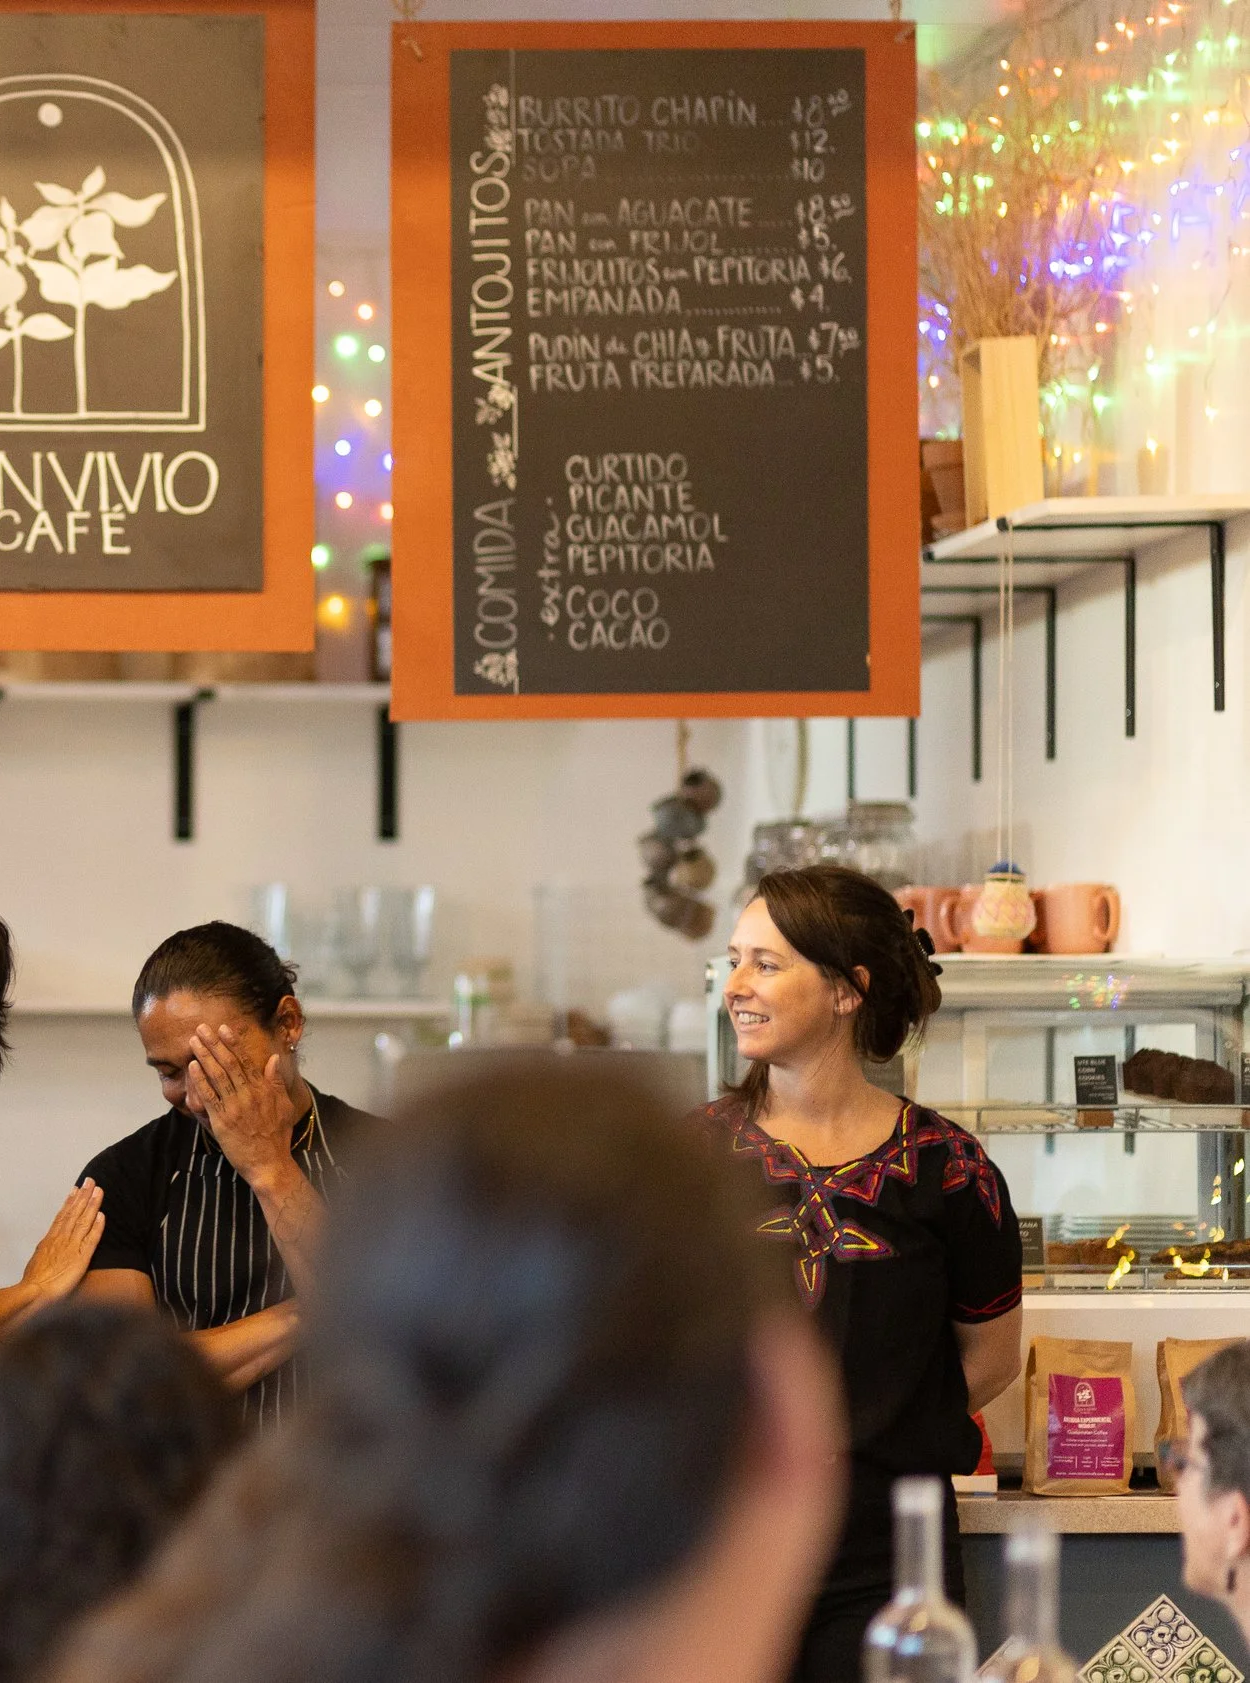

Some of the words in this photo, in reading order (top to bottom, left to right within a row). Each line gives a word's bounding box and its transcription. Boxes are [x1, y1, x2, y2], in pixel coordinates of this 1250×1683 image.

[518, 95, 640, 127] BURRITO
[515, 127, 624, 152] TOSTADA
[522, 154, 597, 183] SOPA
[524, 198, 576, 227] PAN
[617, 196, 753, 228] AGUACATE
[525, 228, 577, 254] PAN
[629, 229, 722, 256] FRIJOL
[469, 151, 514, 388] ANTOJITOS
[526, 256, 661, 287] FRIJOLITOS
[693, 255, 812, 287] PEPITORIA
[526, 285, 682, 317] EMPANADA
[717, 324, 796, 360] FRUTA
[529, 360, 622, 393] FRUTA
[630, 358, 775, 390] PREPARADA
[565, 452, 689, 484] CURTIDO
[569, 480, 695, 513] PICANTE
[565, 511, 729, 543] GUACAMOL
[473, 497, 519, 649] COMIDA
[566, 542, 716, 576] PEPITORIA
[565, 584, 659, 621] COCO
[567, 617, 671, 651] CACAO
